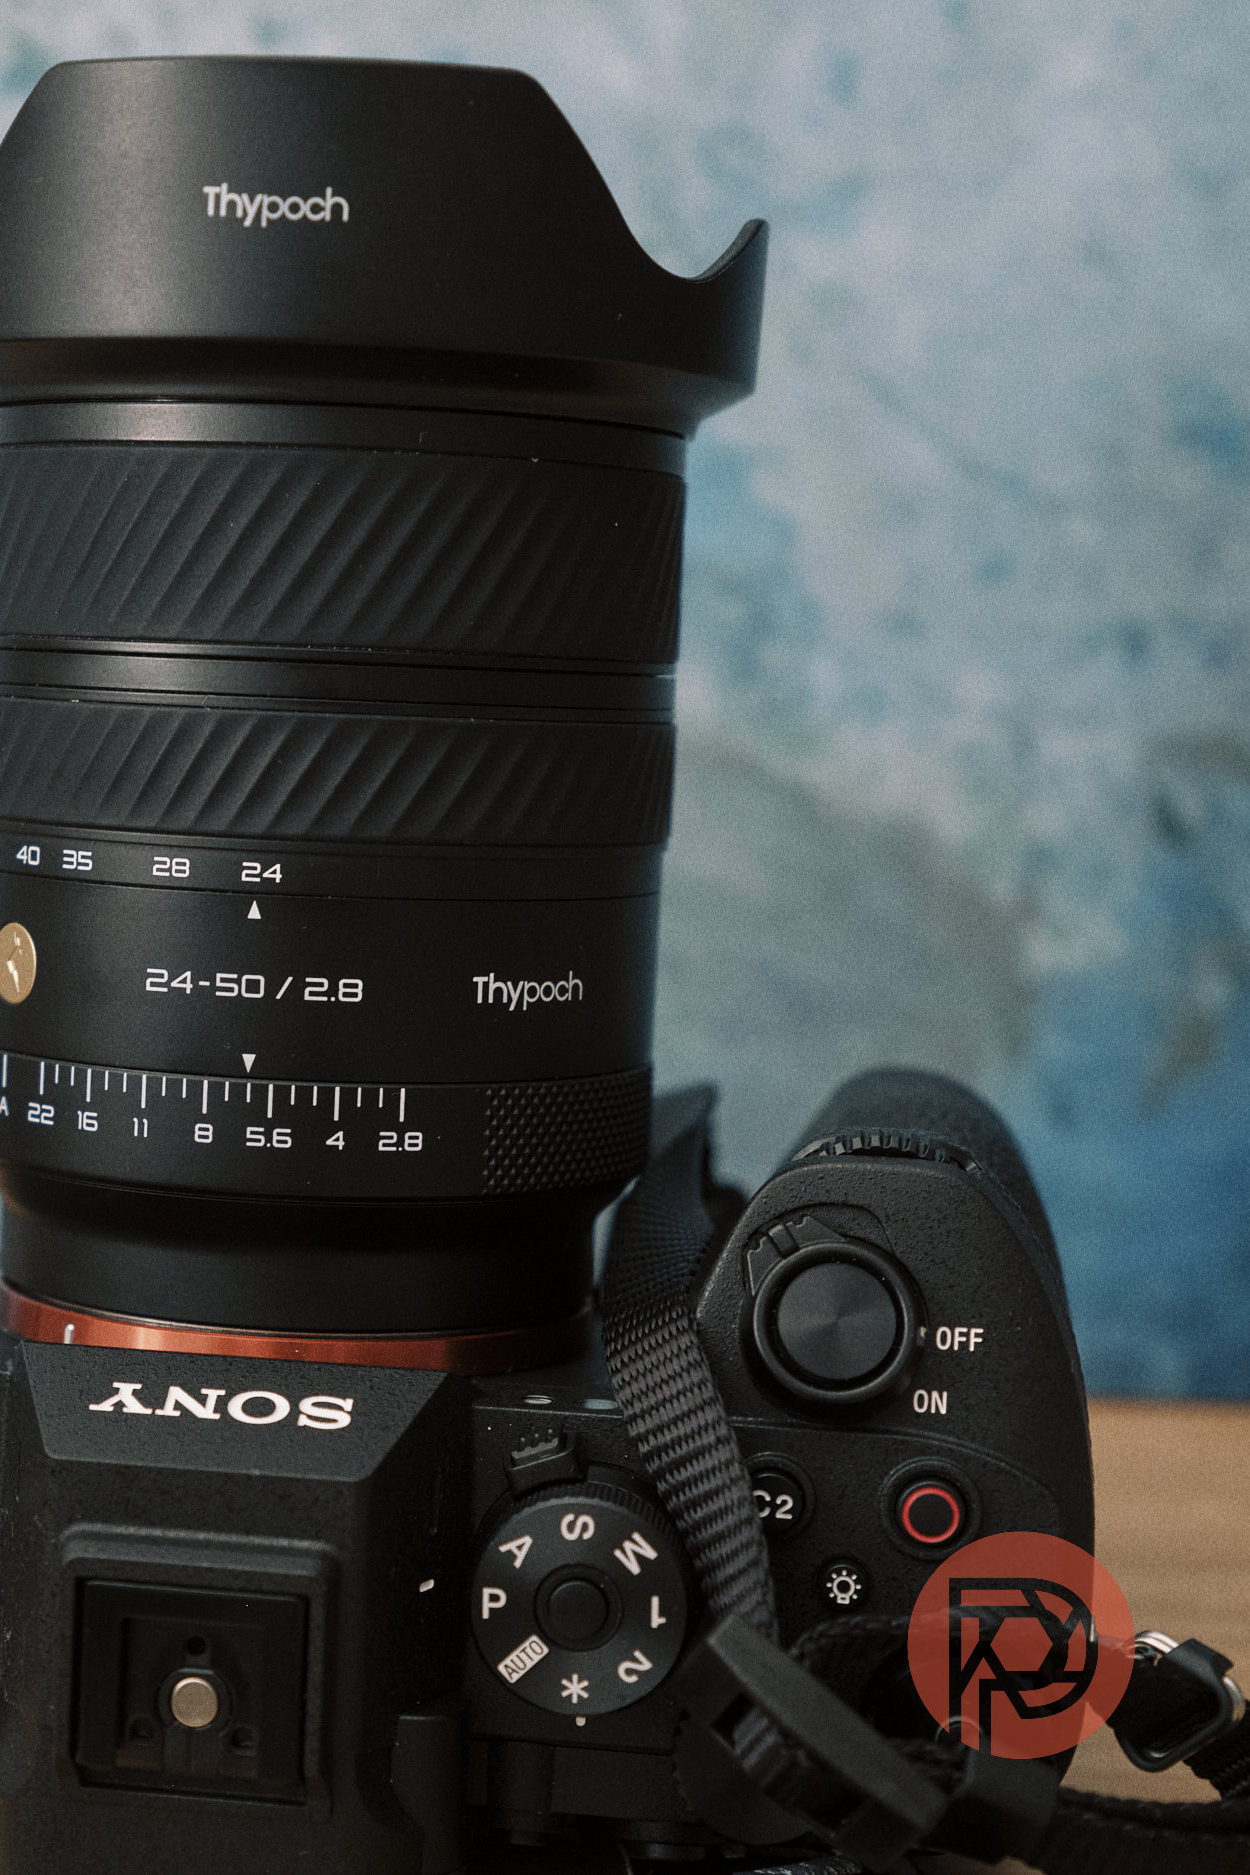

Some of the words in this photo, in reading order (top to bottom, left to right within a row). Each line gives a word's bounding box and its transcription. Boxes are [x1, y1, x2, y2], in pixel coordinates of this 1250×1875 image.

[201, 182, 349, 228] Thypoch
[15, 845, 41, 866] 40
[62, 849, 93, 871] 35
[152, 856, 190, 878] 28
[241, 861, 283, 884] 24
[145, 967, 265, 999] 24-50
[303, 977, 364, 1003] 2.8
[472, 970, 583, 1012] Thypoch
[27, 1101, 55, 1126] 22
[77, 1110, 99, 1132] 16
[132, 1117, 149, 1138] 11
[194, 1122, 214, 1144] 8
[245, 1126, 292, 1149] 5.6
[325, 1130, 346, 1151] 4
[378, 1131, 423, 1153] 2.8
[935, 1326, 984, 1352] OFF
[88, 1380, 354, 1431] SONY
[913, 1389, 948, 1415] ON
[560, 1513, 595, 1541] S
[498, 1534, 533, 1569] A
[613, 1531, 658, 1576] M
[481, 1586, 507, 1620] P
[650, 1595, 667, 1629] 1
[500, 1637, 547, 1681] AUTO
[617, 1650, 653, 1684] 2
